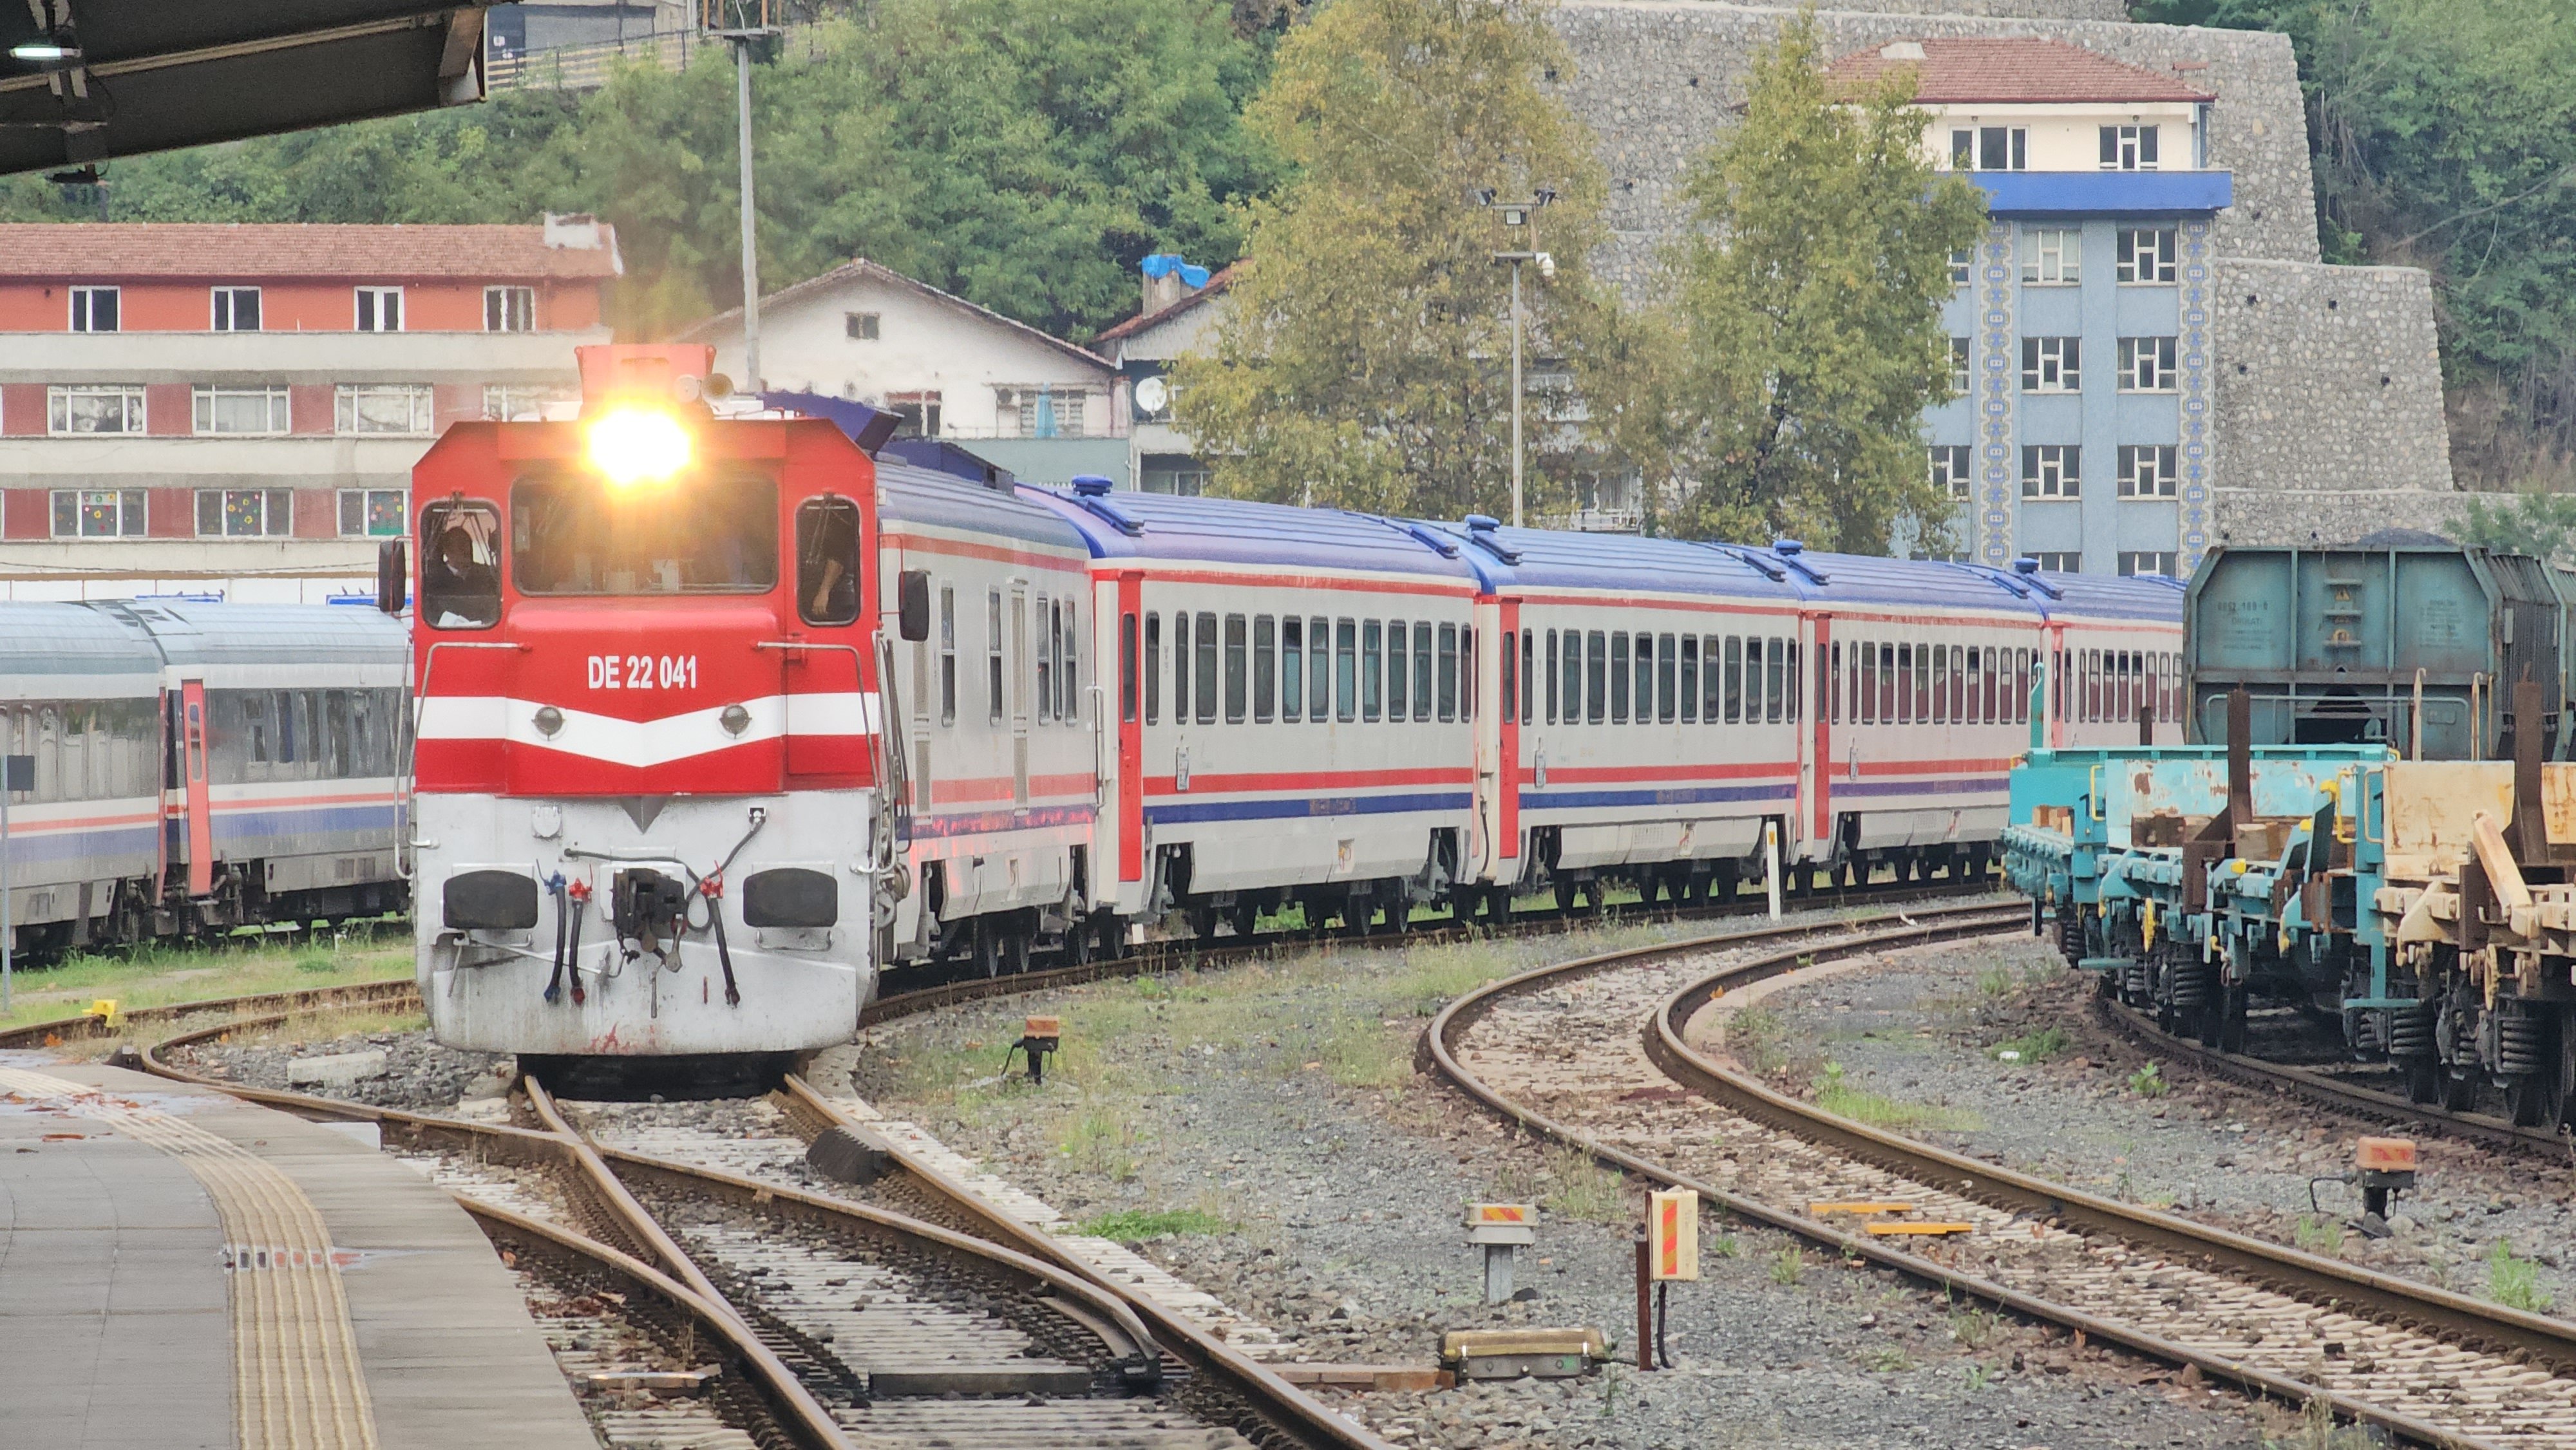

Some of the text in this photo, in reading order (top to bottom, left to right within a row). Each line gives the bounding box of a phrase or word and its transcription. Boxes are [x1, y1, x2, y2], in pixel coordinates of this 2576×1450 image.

[587, 655, 696, 690] DE 22 041
